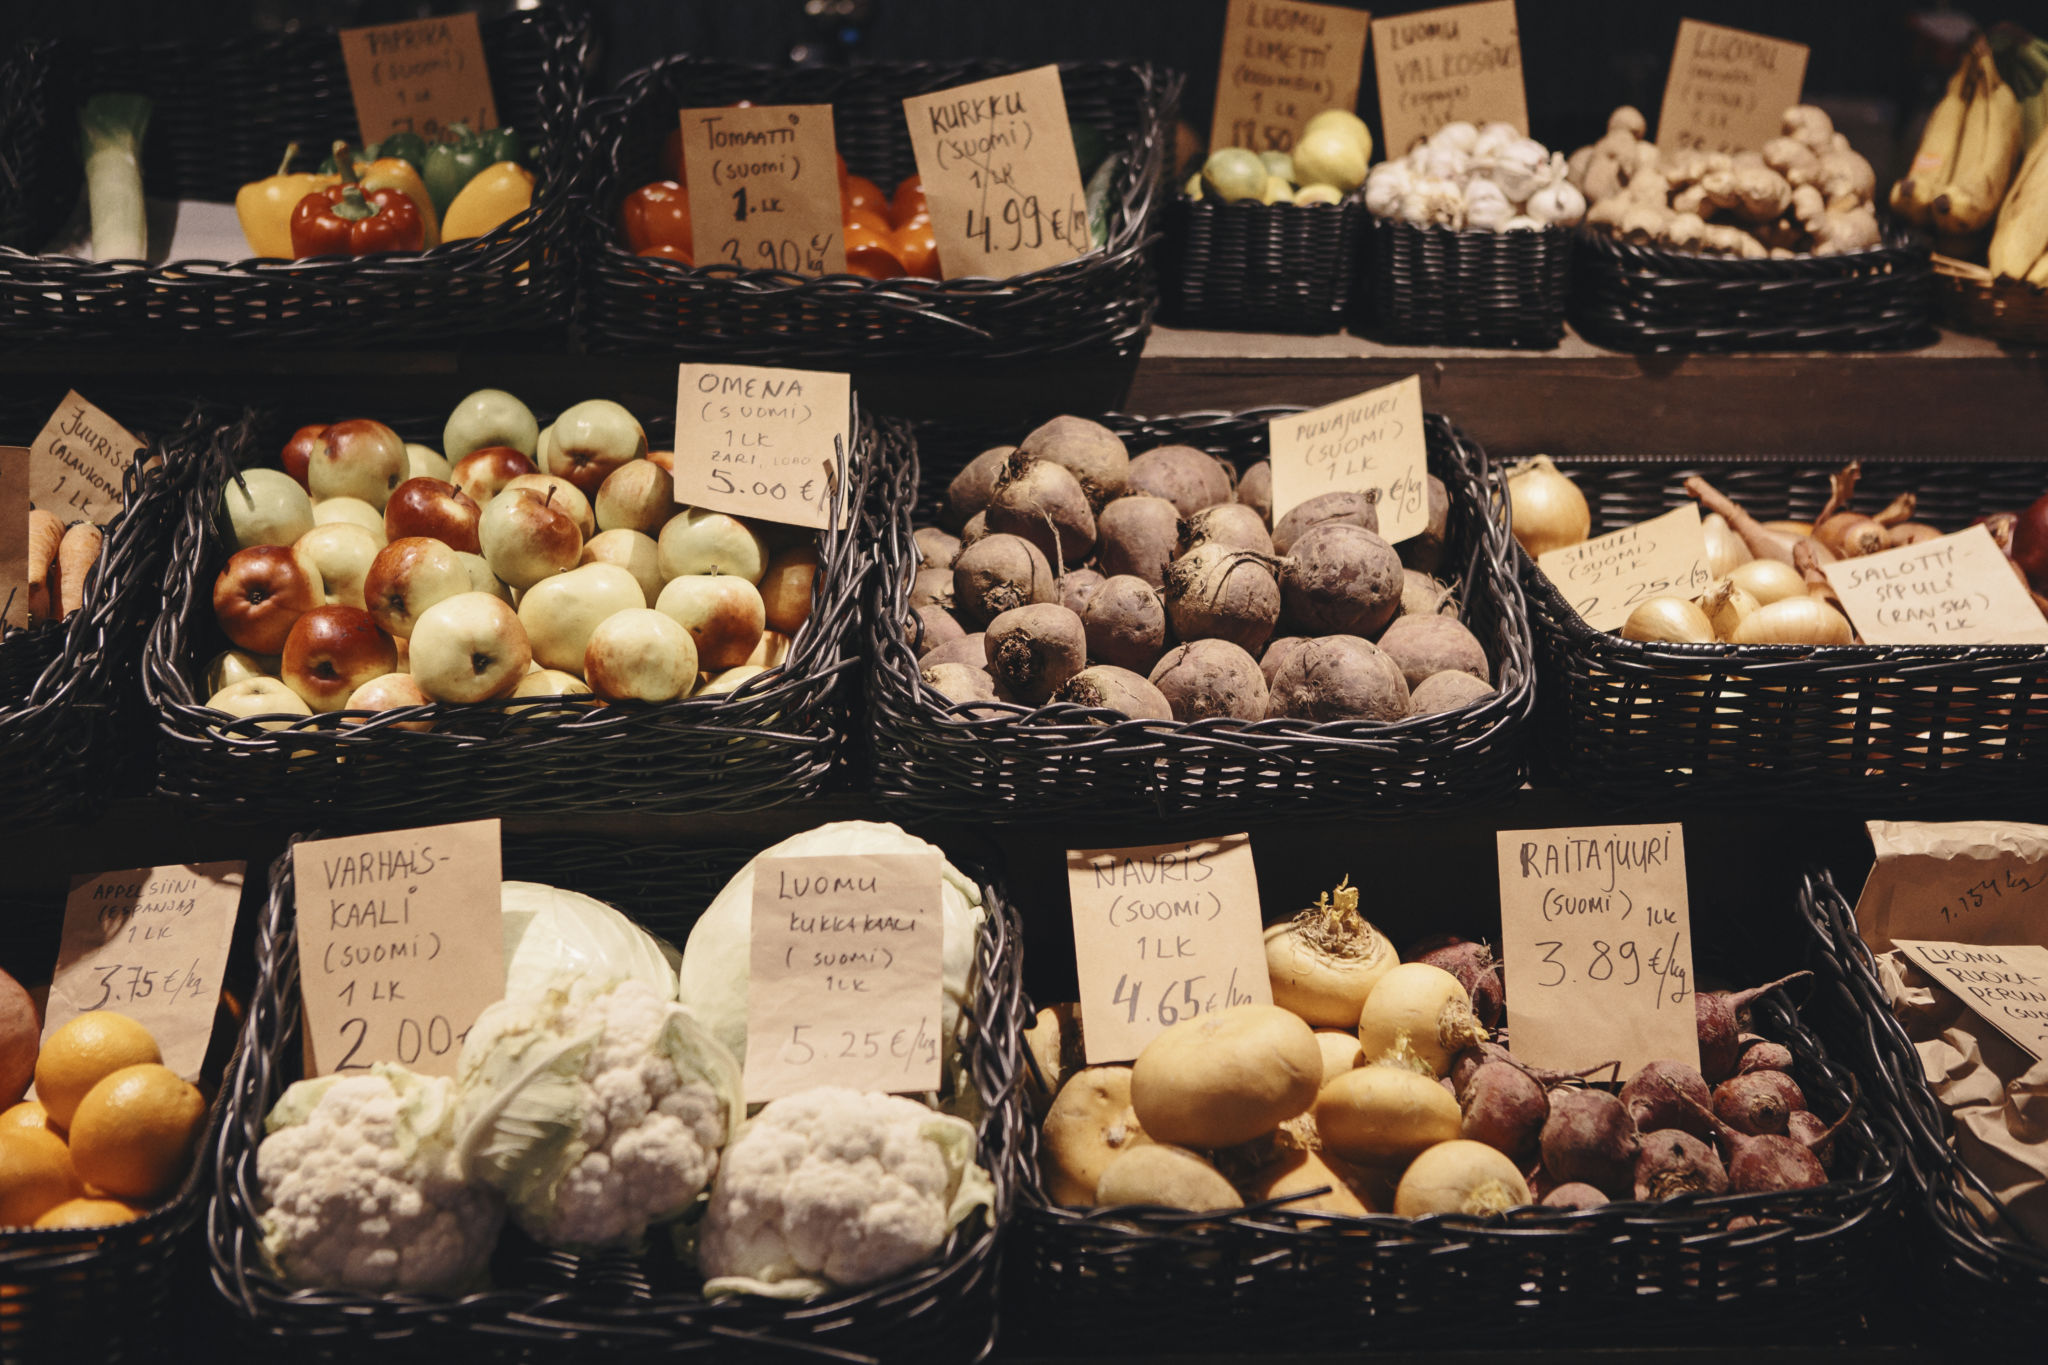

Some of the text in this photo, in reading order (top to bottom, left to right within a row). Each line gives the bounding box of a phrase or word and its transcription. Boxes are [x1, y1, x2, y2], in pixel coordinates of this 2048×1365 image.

[929, 92, 1026, 135] KURKKU
[966, 195, 1042, 253] 4.99
[699, 374, 802, 399] OMENA
[1297, 397, 1397, 442] PUNAJUURI
[53, 476, 66, 493] 1
[707, 469, 786, 500] 5.00
[778, 871, 876, 899] LUOMU
[1094, 844, 1214, 888] NAURIS
[330, 885, 418, 931] KAALI
[1535, 940, 1640, 986] 3.89
[1916, 946, 2008, 966] LUOMU
[78, 964, 158, 1012] 3.75
[338, 980, 405, 1006] 1 LK
[1112, 974, 1206, 1027] 4.65
[784, 1023, 884, 1065] 5.25
